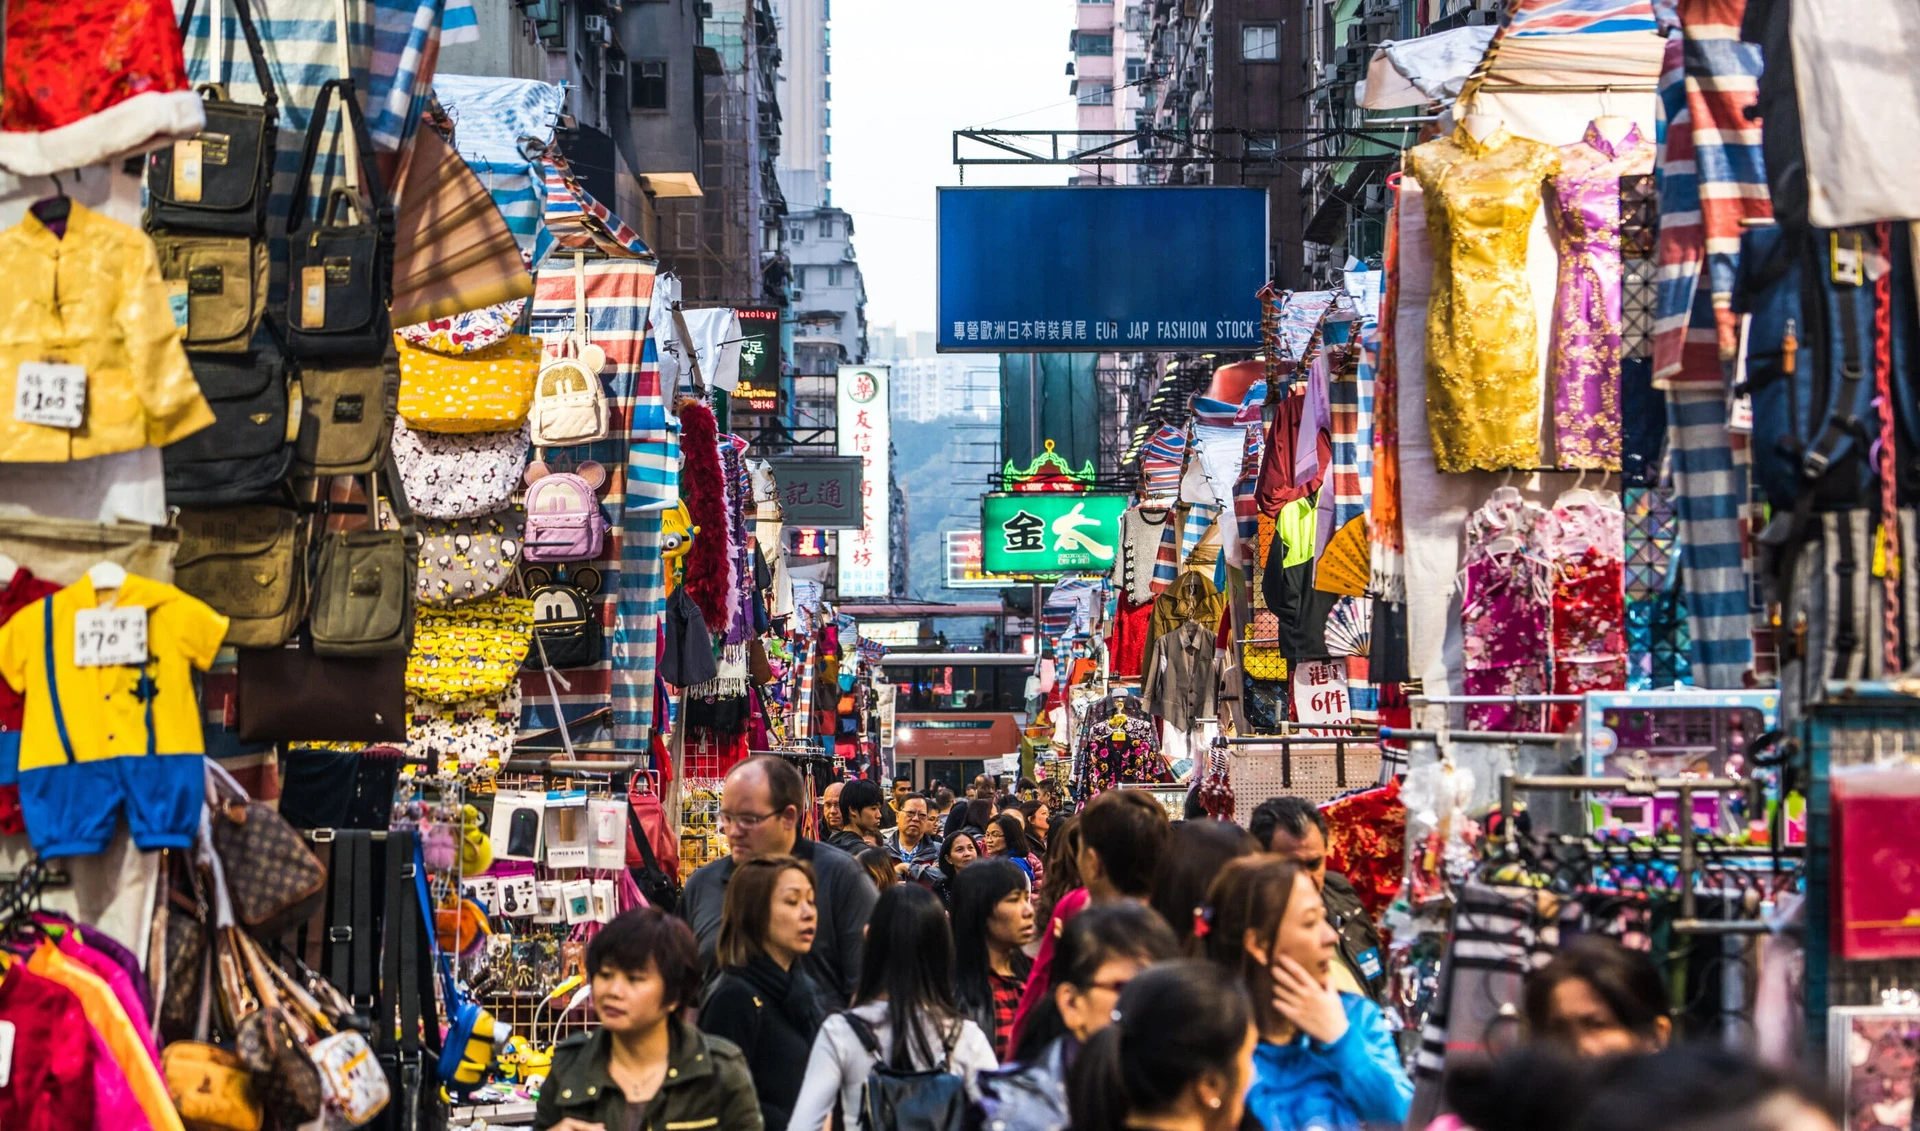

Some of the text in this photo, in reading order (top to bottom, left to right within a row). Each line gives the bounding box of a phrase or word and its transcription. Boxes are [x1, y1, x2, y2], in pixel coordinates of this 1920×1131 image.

[953, 320, 1254, 340] 專營歐洲日本時裝貨尾 EUR JAP FASHION STOCK
[1310, 689, 1347, 715] 6件
